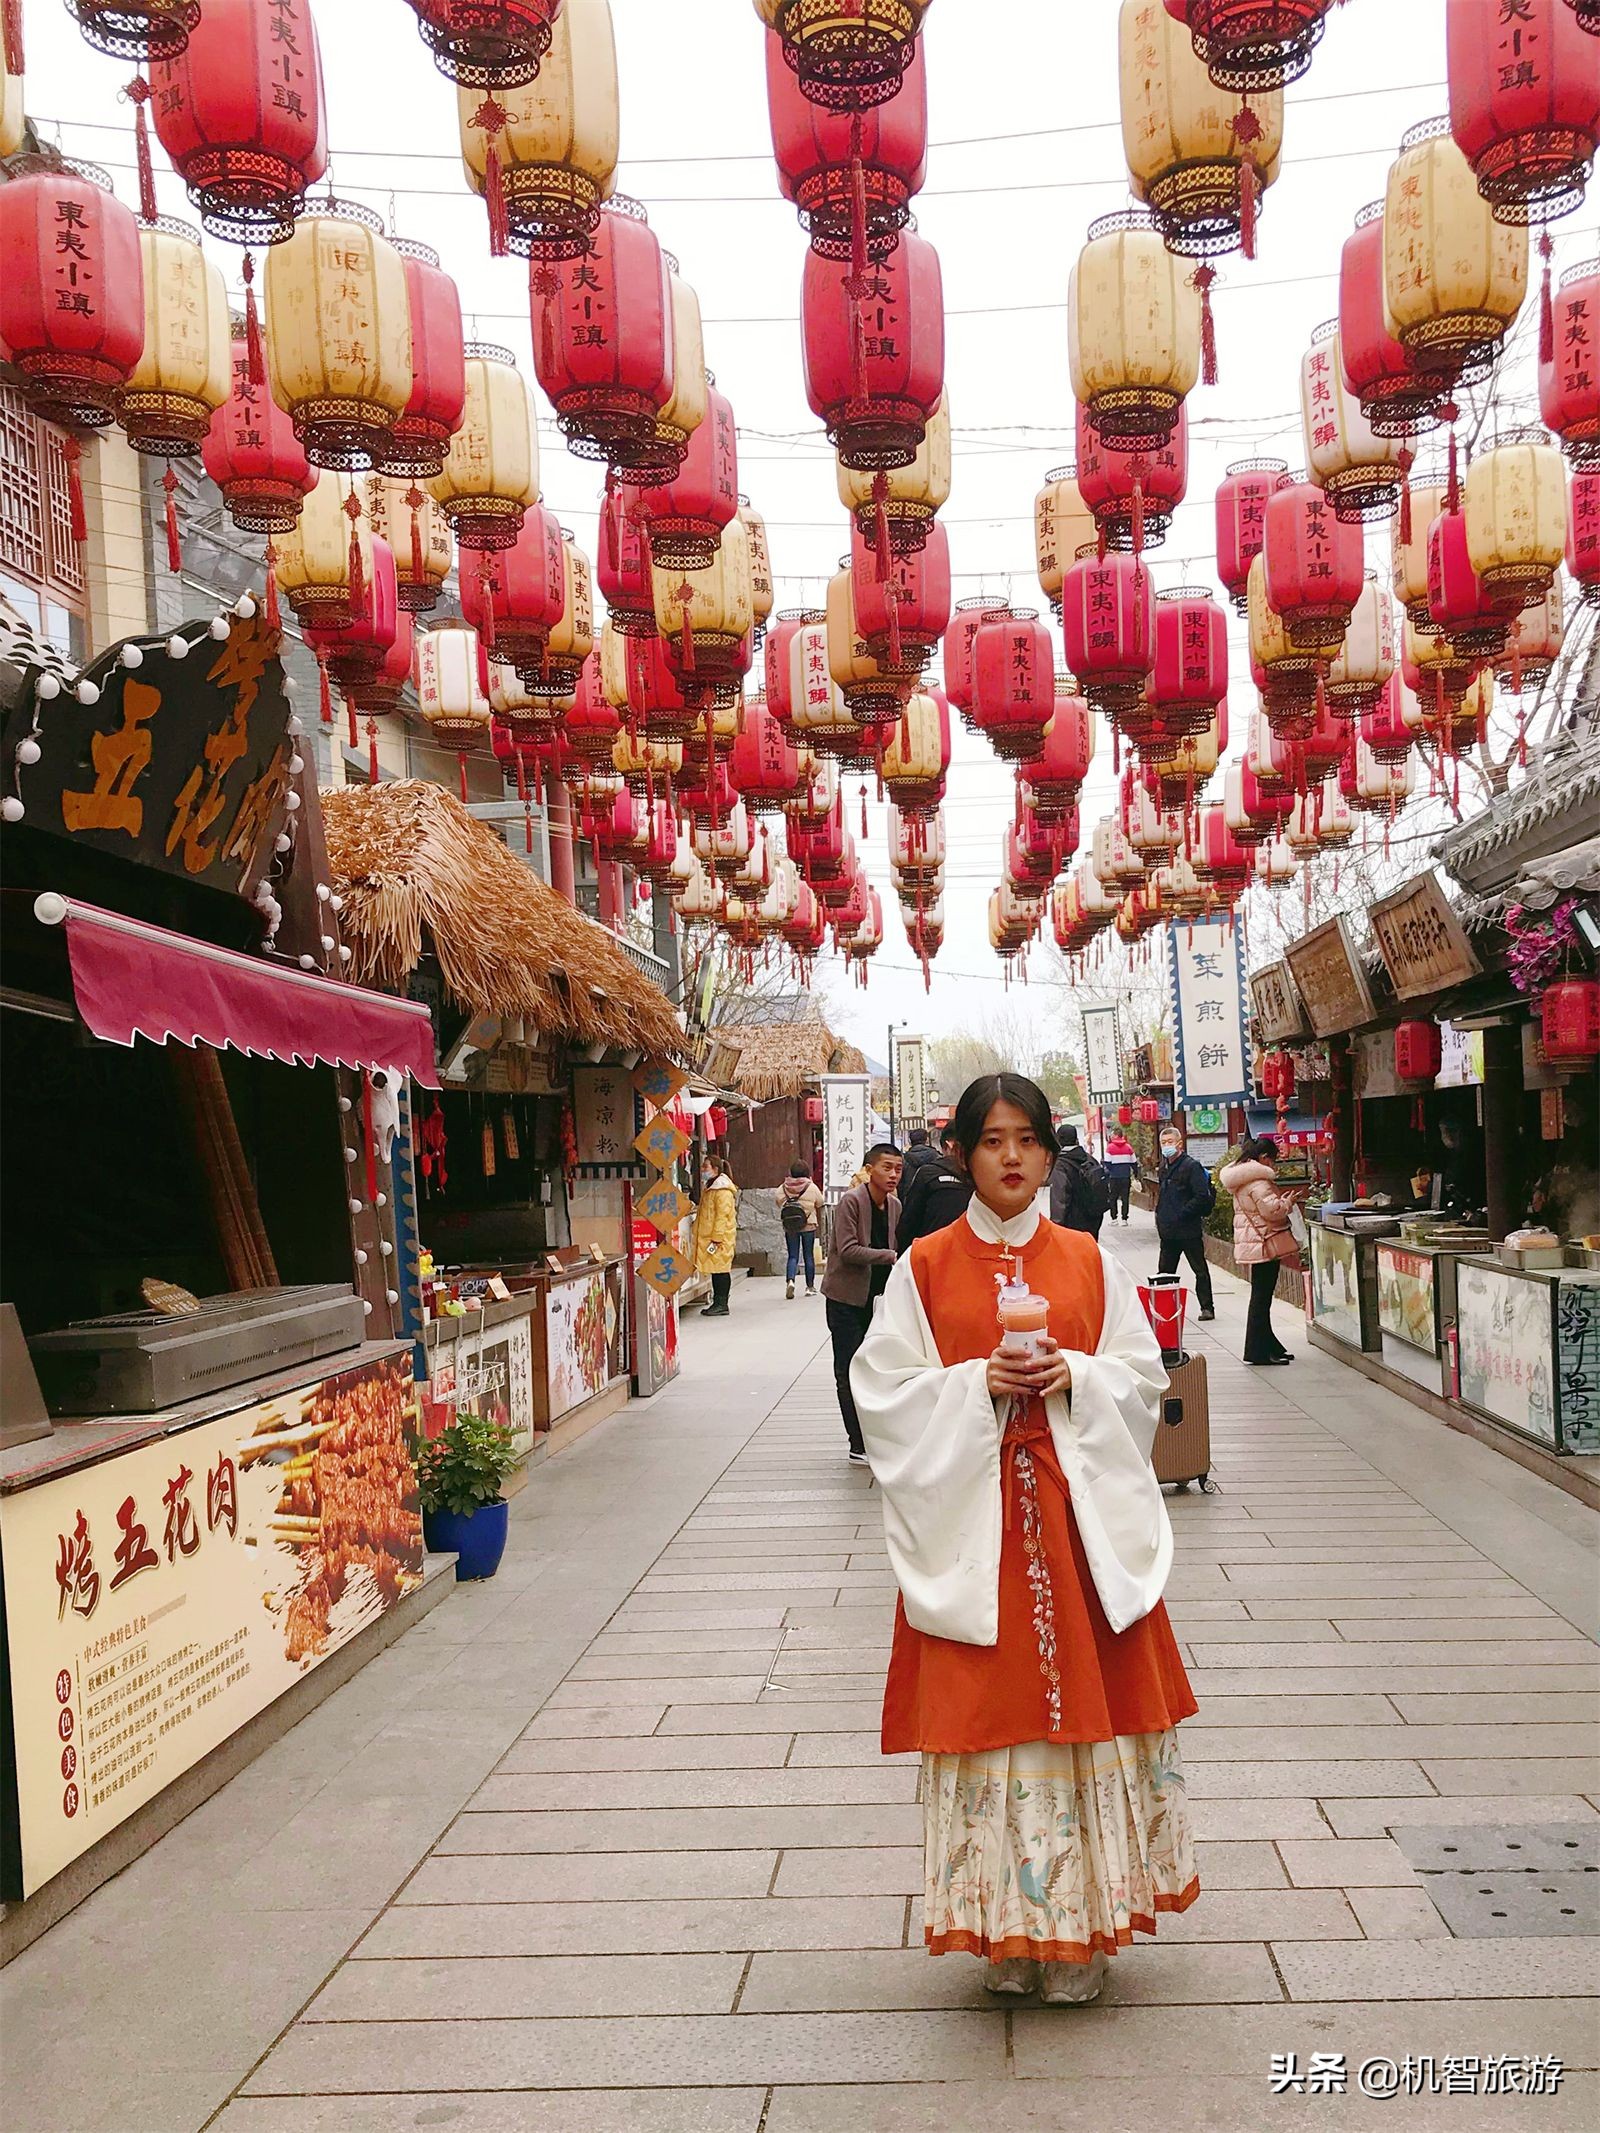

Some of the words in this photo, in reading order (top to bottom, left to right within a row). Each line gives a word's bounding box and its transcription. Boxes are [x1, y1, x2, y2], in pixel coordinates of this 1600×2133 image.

[55, 199, 96, 320] 東夷小鎮
[1563, 299, 1593, 395] 東夷小鎮
[232, 358, 266, 450] 東夷小鎮
[1308, 351, 1339, 450] 東夷小鎮
[716, 407, 733, 502] 東夷小鎮
[746, 519, 772, 595] 東夷小鎮
[1039, 496, 1059, 574] 東夷小鎮
[1305, 500, 1334, 580] 東夷小鎮
[572, 557, 594, 640] 東夷小鎮
[1088, 568, 1118, 650] 東夷小鎮
[806, 633, 831, 706] 東夷小鎮
[1011, 636, 1035, 705] 東夷小鎮
[1183, 610, 1209, 683] 東夷小鎮
[763, 717, 783, 774] 東夷小鎮
[1191, 952, 1230, 1069] 菜煎餅
[56, 1450, 240, 1624] 烤五花肉
[84, 1615, 147, 1664] 中式经典特色美食
[57, 1671, 77, 1817] 特色美食
